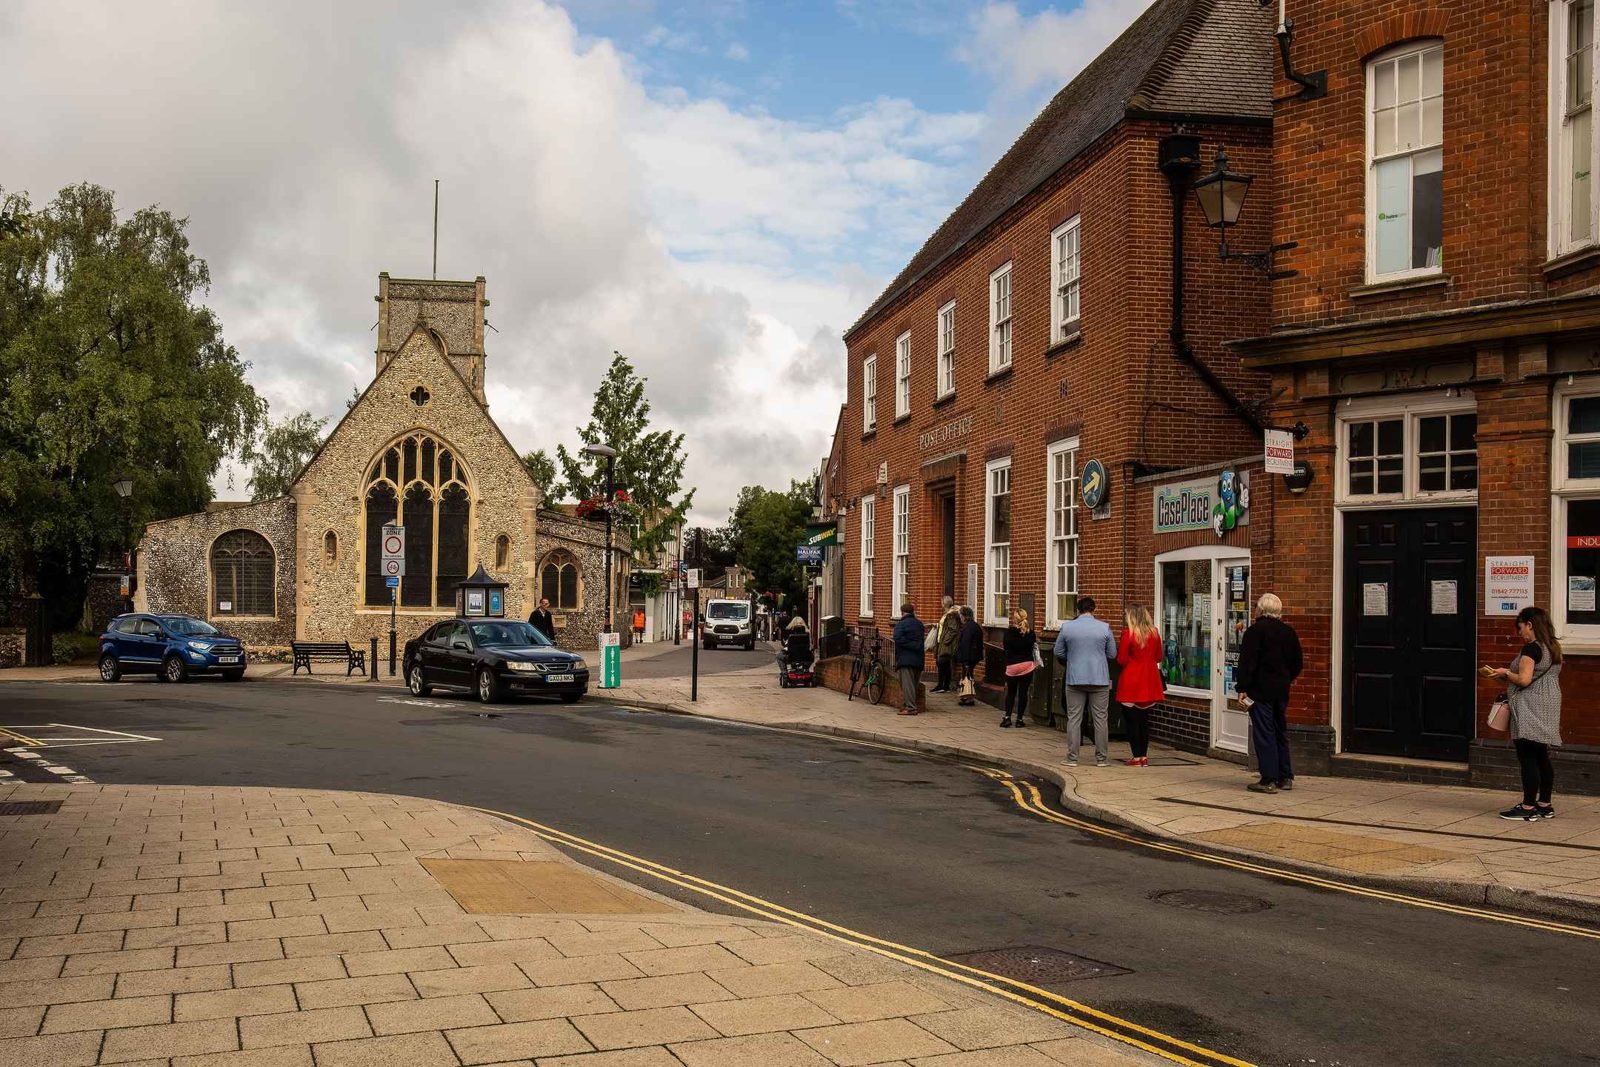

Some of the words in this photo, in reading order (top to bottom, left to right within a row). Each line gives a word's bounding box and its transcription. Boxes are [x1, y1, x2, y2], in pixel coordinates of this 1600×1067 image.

[920, 429, 939, 450] POST
[943, 416, 973, 441] OFFICE
[1266, 438, 1292, 448] STRAIGHT
[1267, 447, 1292, 458] FORWARD
[1267, 458, 1293, 467] RECRUITMENT
[1158, 491, 1209, 526] CasePlace
[808, 528, 836, 545] SUBWAY
